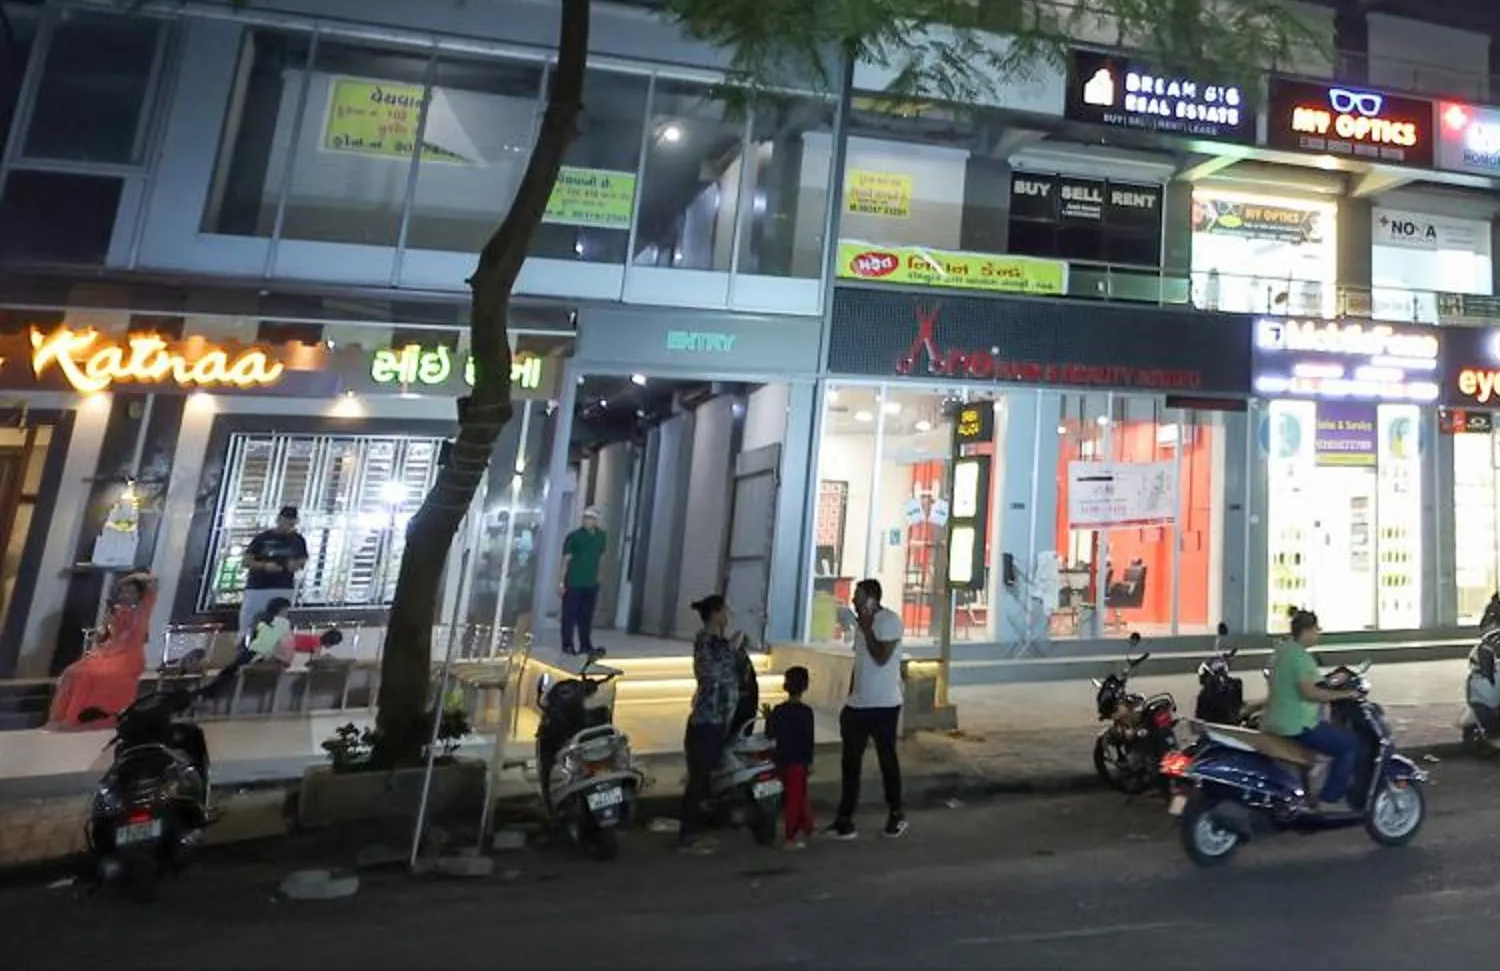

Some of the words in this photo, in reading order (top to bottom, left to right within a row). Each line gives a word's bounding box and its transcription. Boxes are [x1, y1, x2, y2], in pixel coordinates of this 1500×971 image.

[1125, 72, 1196, 99] DREAM
[1124, 92, 1171, 116] REAL
[1176, 100, 1239, 126] ESTATE
[1292, 107, 1331, 134] MY
[1335, 114, 1417, 147] OPTICS
[1013, 180, 1051, 198] BUY
[1061, 184, 1103, 202] SELL
[1111, 189, 1157, 208] RENT
[1391, 219, 1437, 238] NOA
